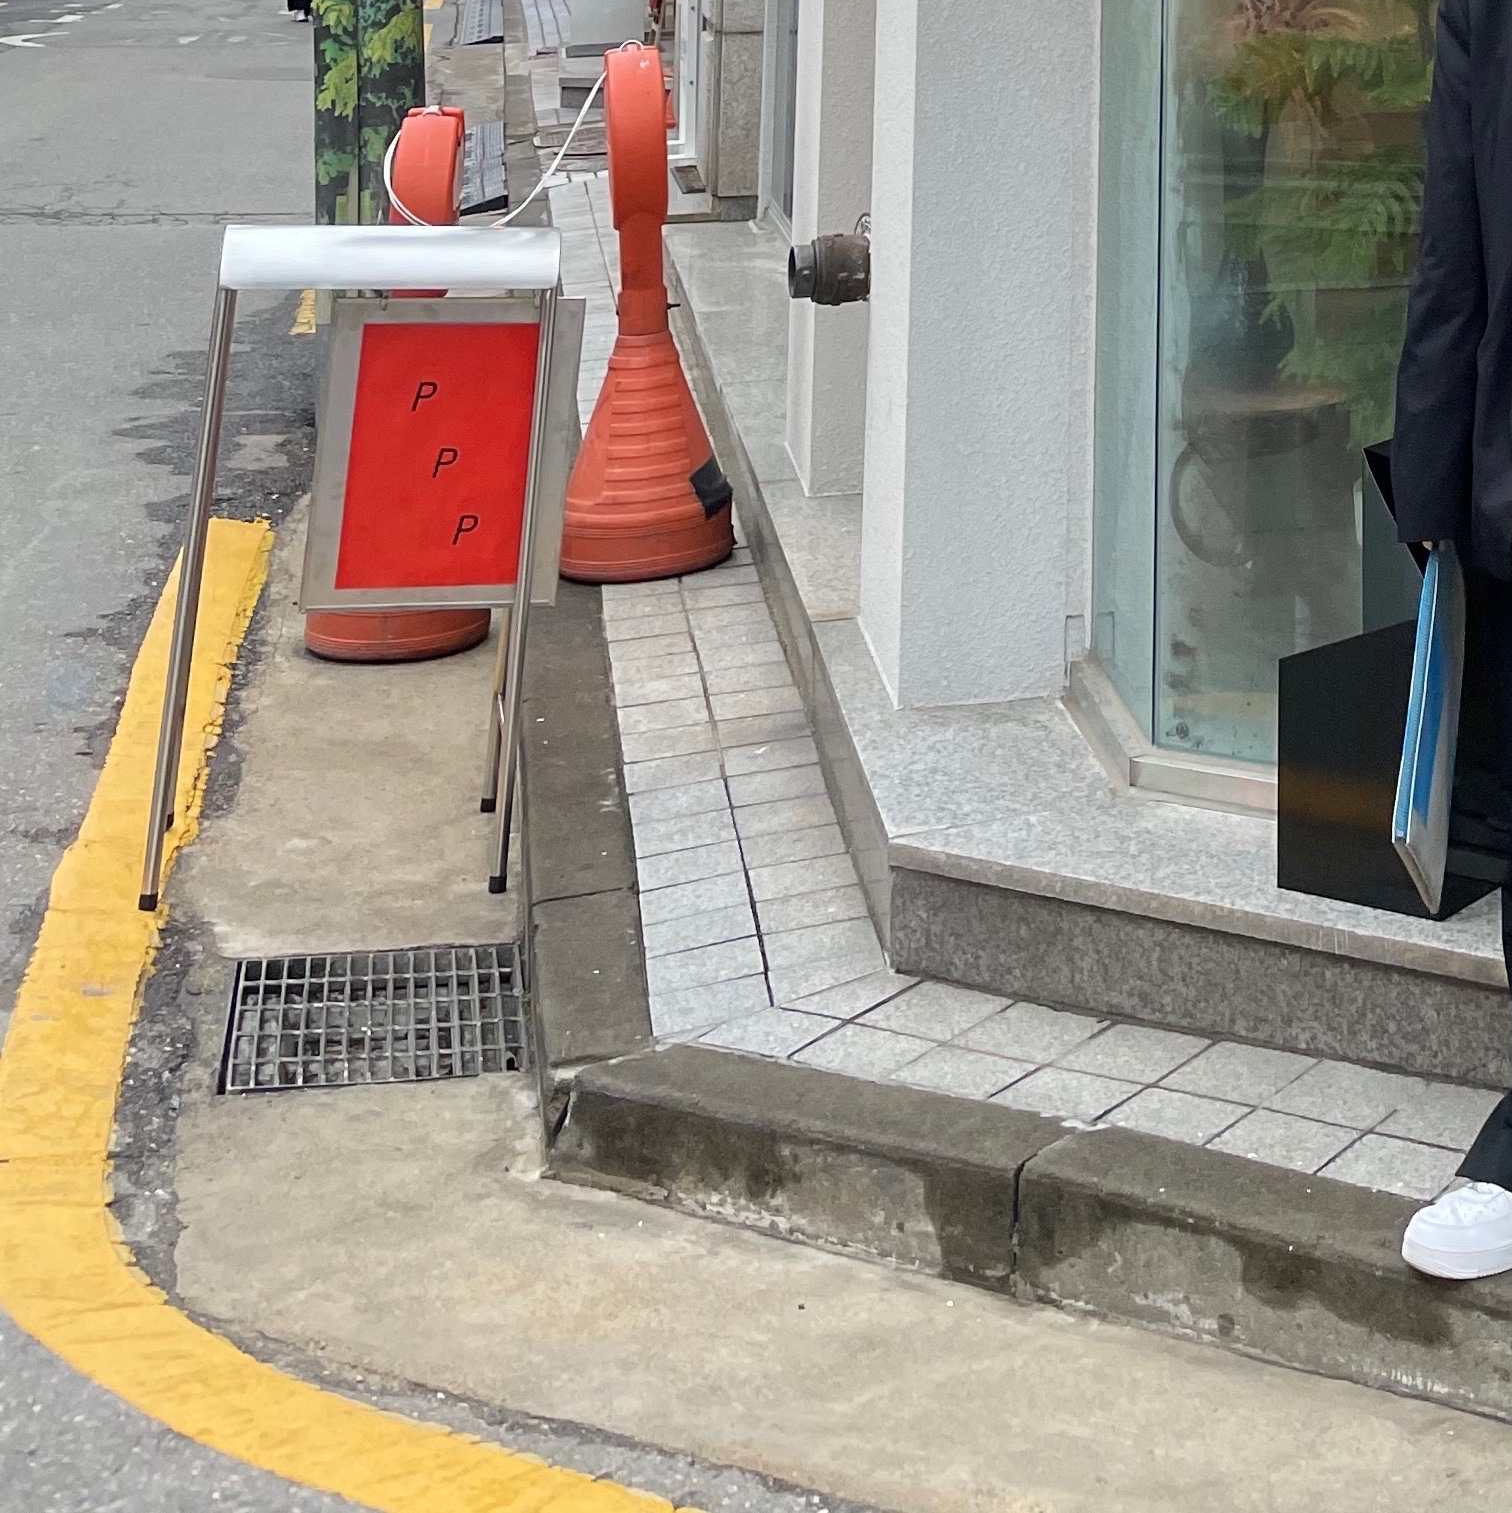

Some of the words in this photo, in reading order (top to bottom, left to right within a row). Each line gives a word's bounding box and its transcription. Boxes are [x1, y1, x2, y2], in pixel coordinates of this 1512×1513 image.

[411, 381, 438, 413] P
[432, 447, 458, 479] P
[452, 514, 479, 546] P
